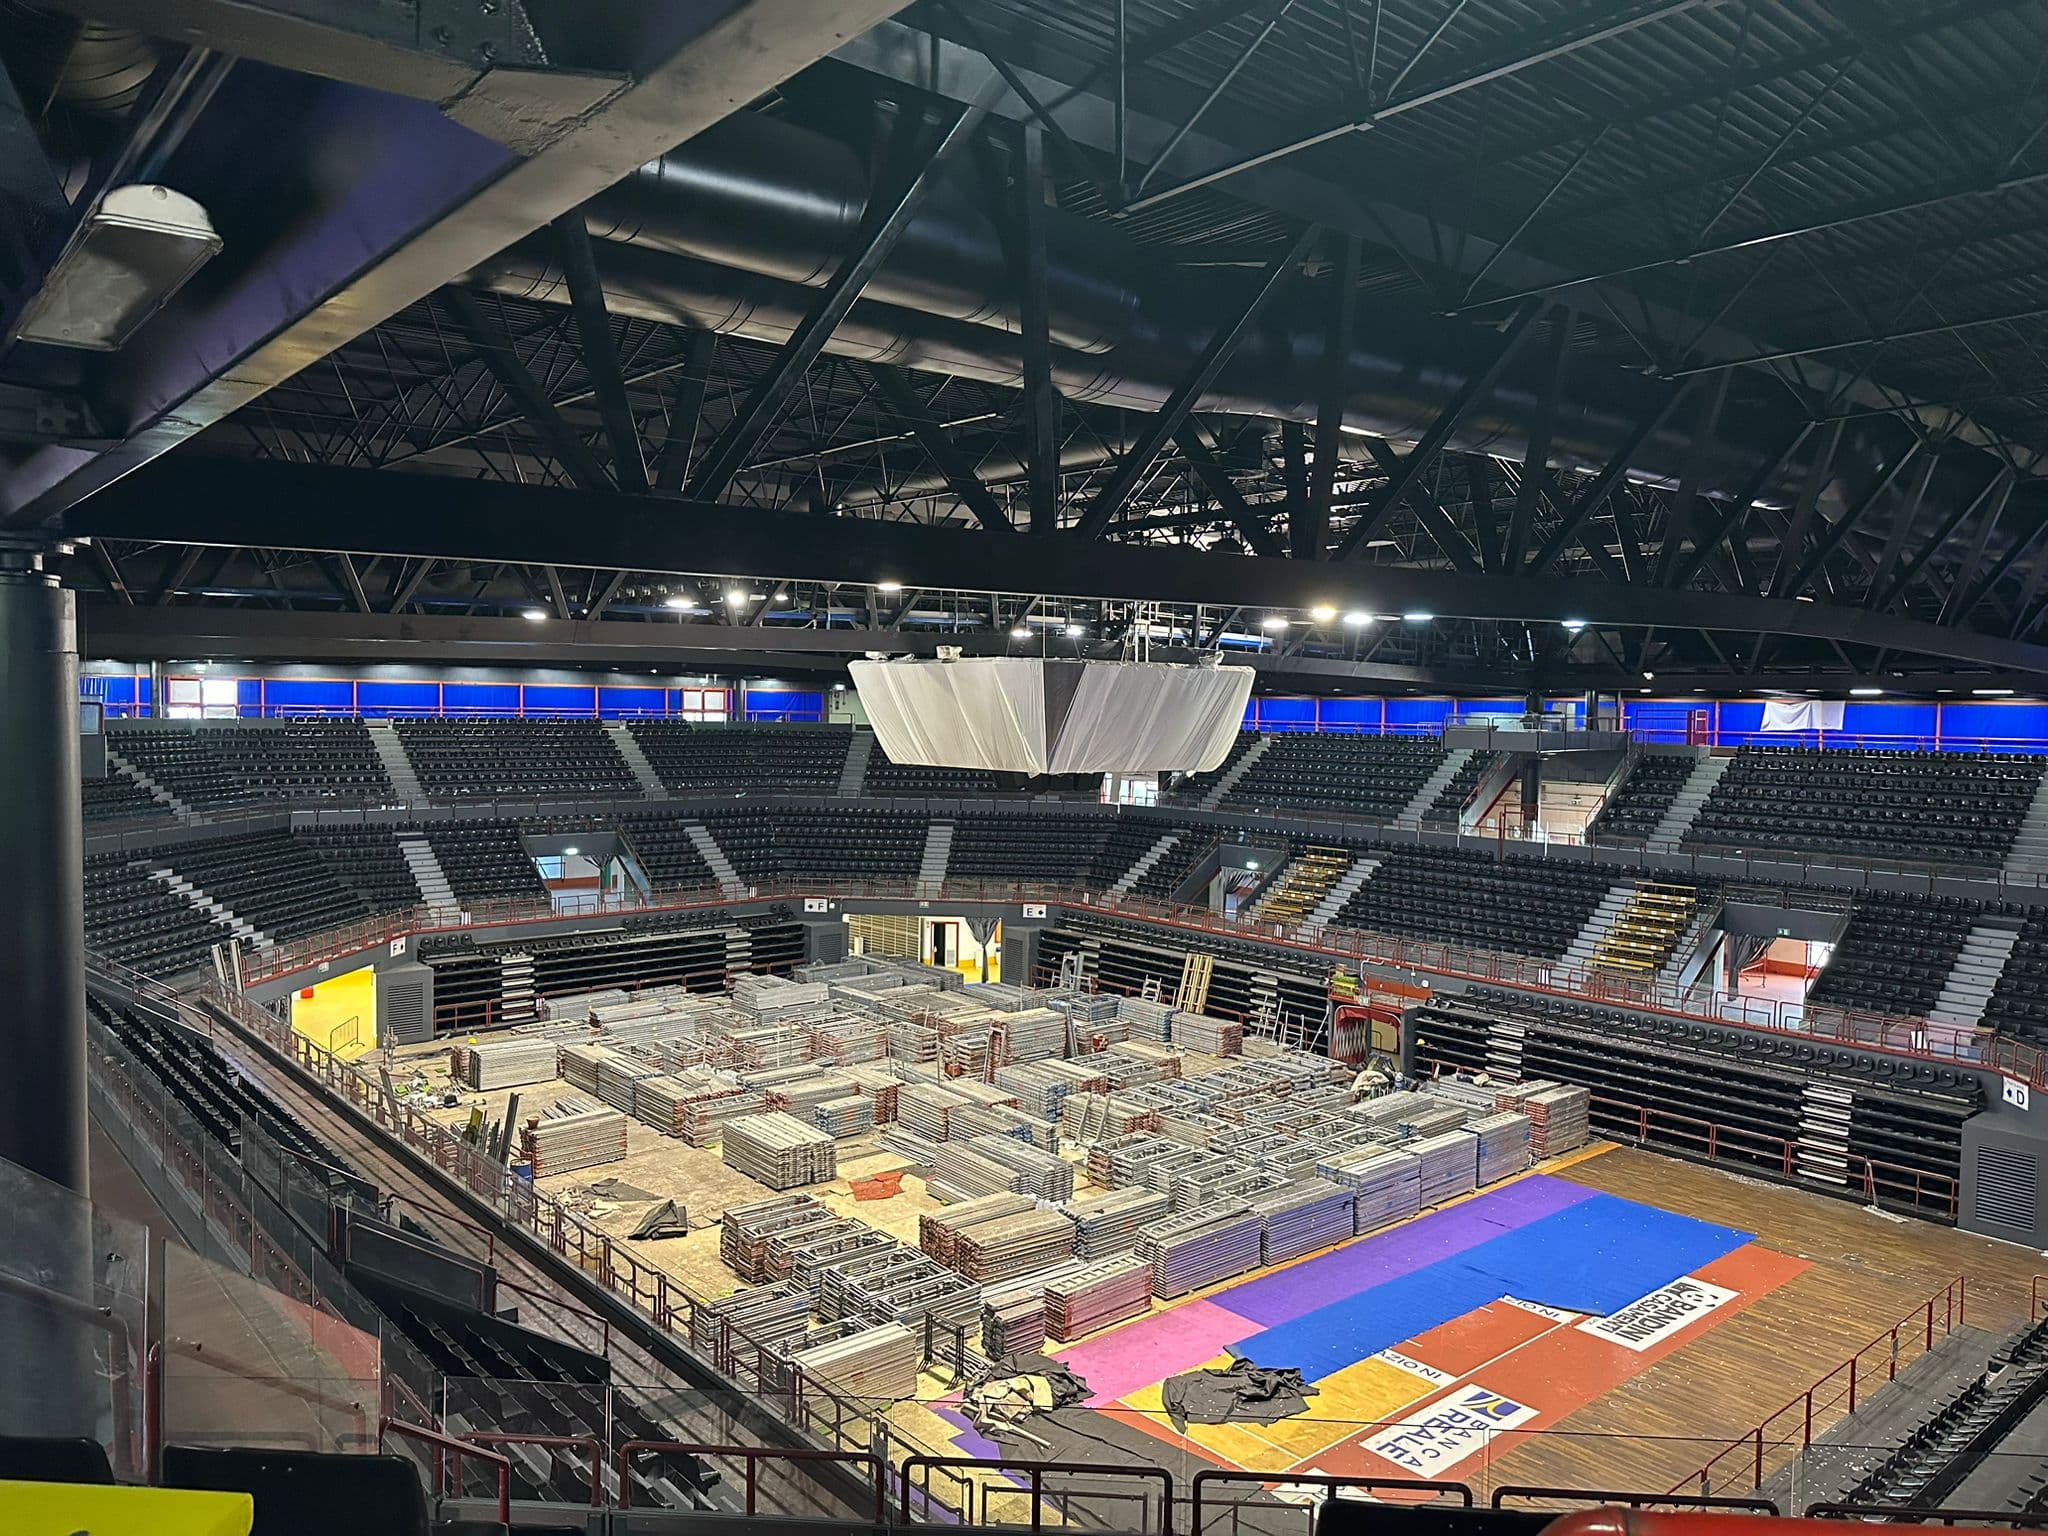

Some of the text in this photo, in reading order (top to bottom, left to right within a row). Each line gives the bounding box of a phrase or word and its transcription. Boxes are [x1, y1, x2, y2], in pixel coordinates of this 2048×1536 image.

[818, 902, 824, 911] F
[1026, 907, 1033, 917] E
[2016, 1089, 2025, 1105] D
[1596, 1293, 1672, 1334] CASAMENTI
[1615, 1301, 1698, 1342] BANDINI
[1376, 1408, 1472, 1460] REALE
[1403, 1419, 1490, 1467] BANCA
